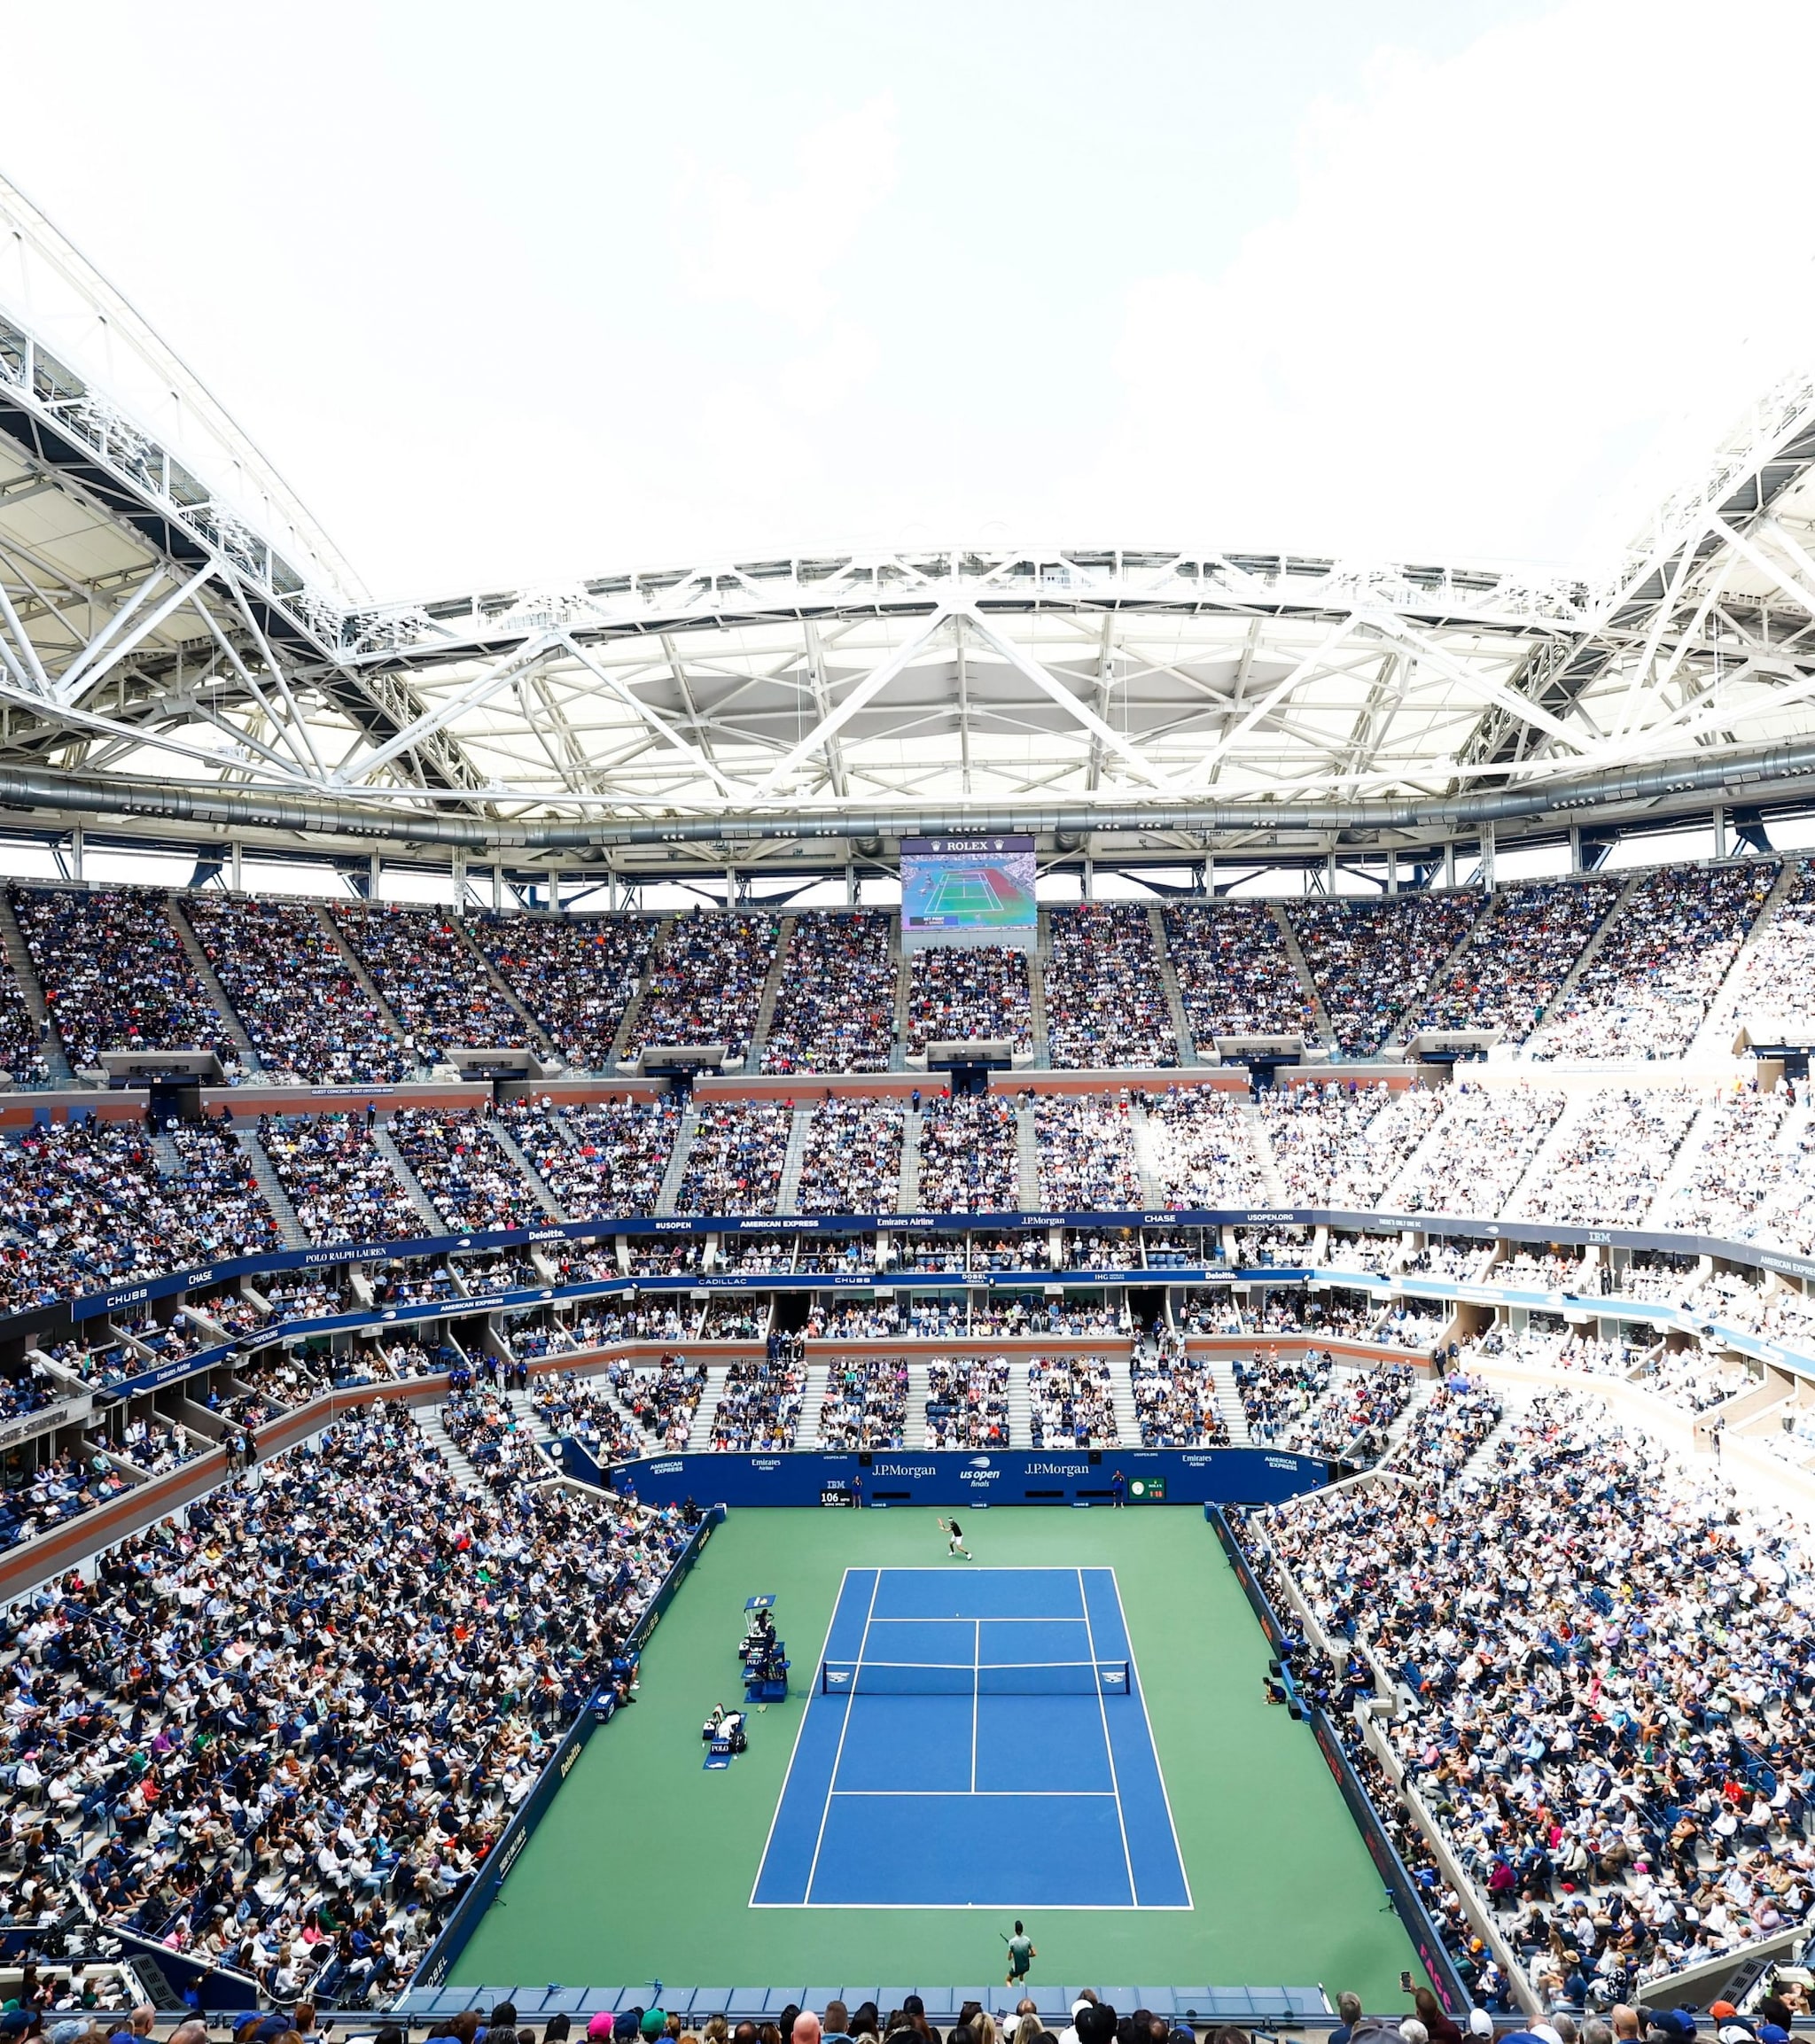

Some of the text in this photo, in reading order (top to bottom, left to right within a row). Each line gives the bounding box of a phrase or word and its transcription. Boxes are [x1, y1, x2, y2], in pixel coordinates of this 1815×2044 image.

[947, 842, 988, 851] ROLEX
[1021, 1216, 1065, 1226] J.P.Morgan
[528, 1230, 565, 1240] Deloitte.
[1588, 1232, 1611, 1242] IBM
[306, 1247, 386, 1263] POLO RALPH LAUREN
[1760, 1256, 1791, 1269] AMERICAN
[188, 1271, 213, 1285] CHASE
[107, 1288, 147, 1307] CHUBB
[440, 1298, 503, 1311] AMERICAN EXPRESS
[157, 1363, 191, 1381] Emirates Airline
[650, 1461, 682, 1471] AMERICAN
[1265, 1457, 1297, 1465] AMERICAN
[872, 1465, 936, 1479] J.P.Morgan
[974, 1471, 1000, 1481] open
[1024, 1464, 1089, 1477] J.P.Morgan
[822, 1493, 838, 1502] 106
[637, 1612, 659, 1650] CHUBB
[425, 1956, 448, 1990] OBEL
